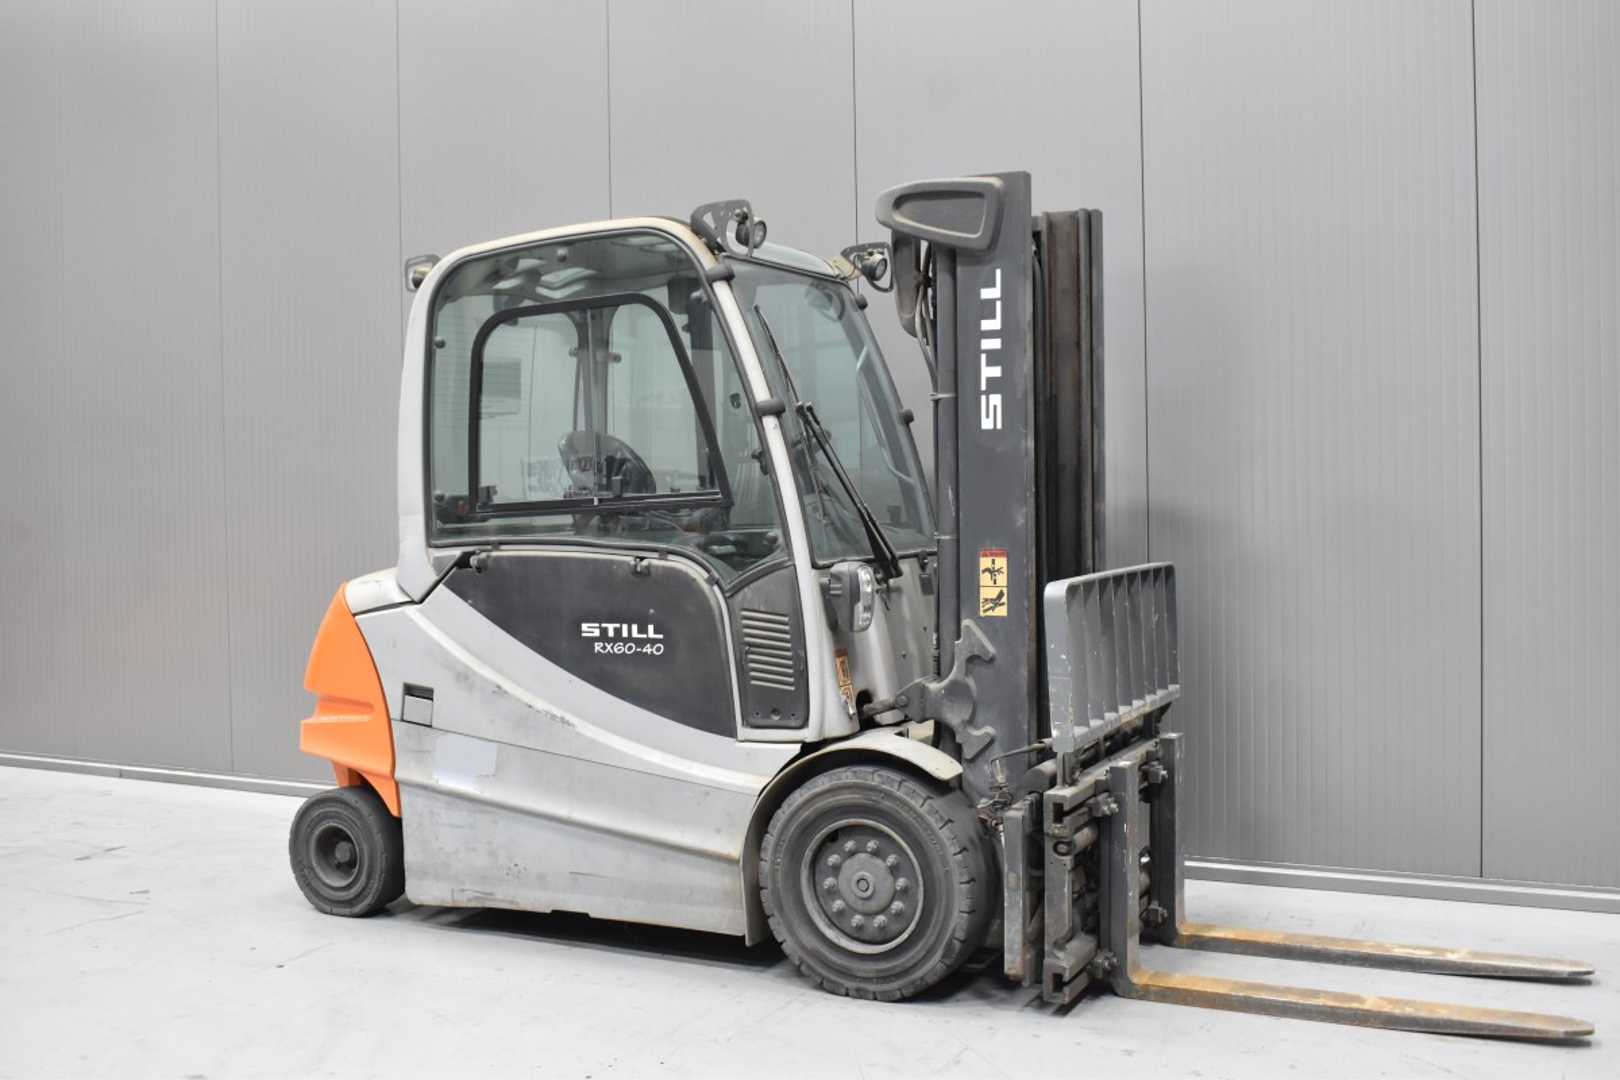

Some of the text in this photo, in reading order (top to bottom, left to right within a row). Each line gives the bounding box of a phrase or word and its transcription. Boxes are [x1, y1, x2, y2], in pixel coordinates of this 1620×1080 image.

[980, 268, 1002, 430] STILL
[581, 622, 664, 639] STILL
[594, 641, 664, 655] RX60-40
